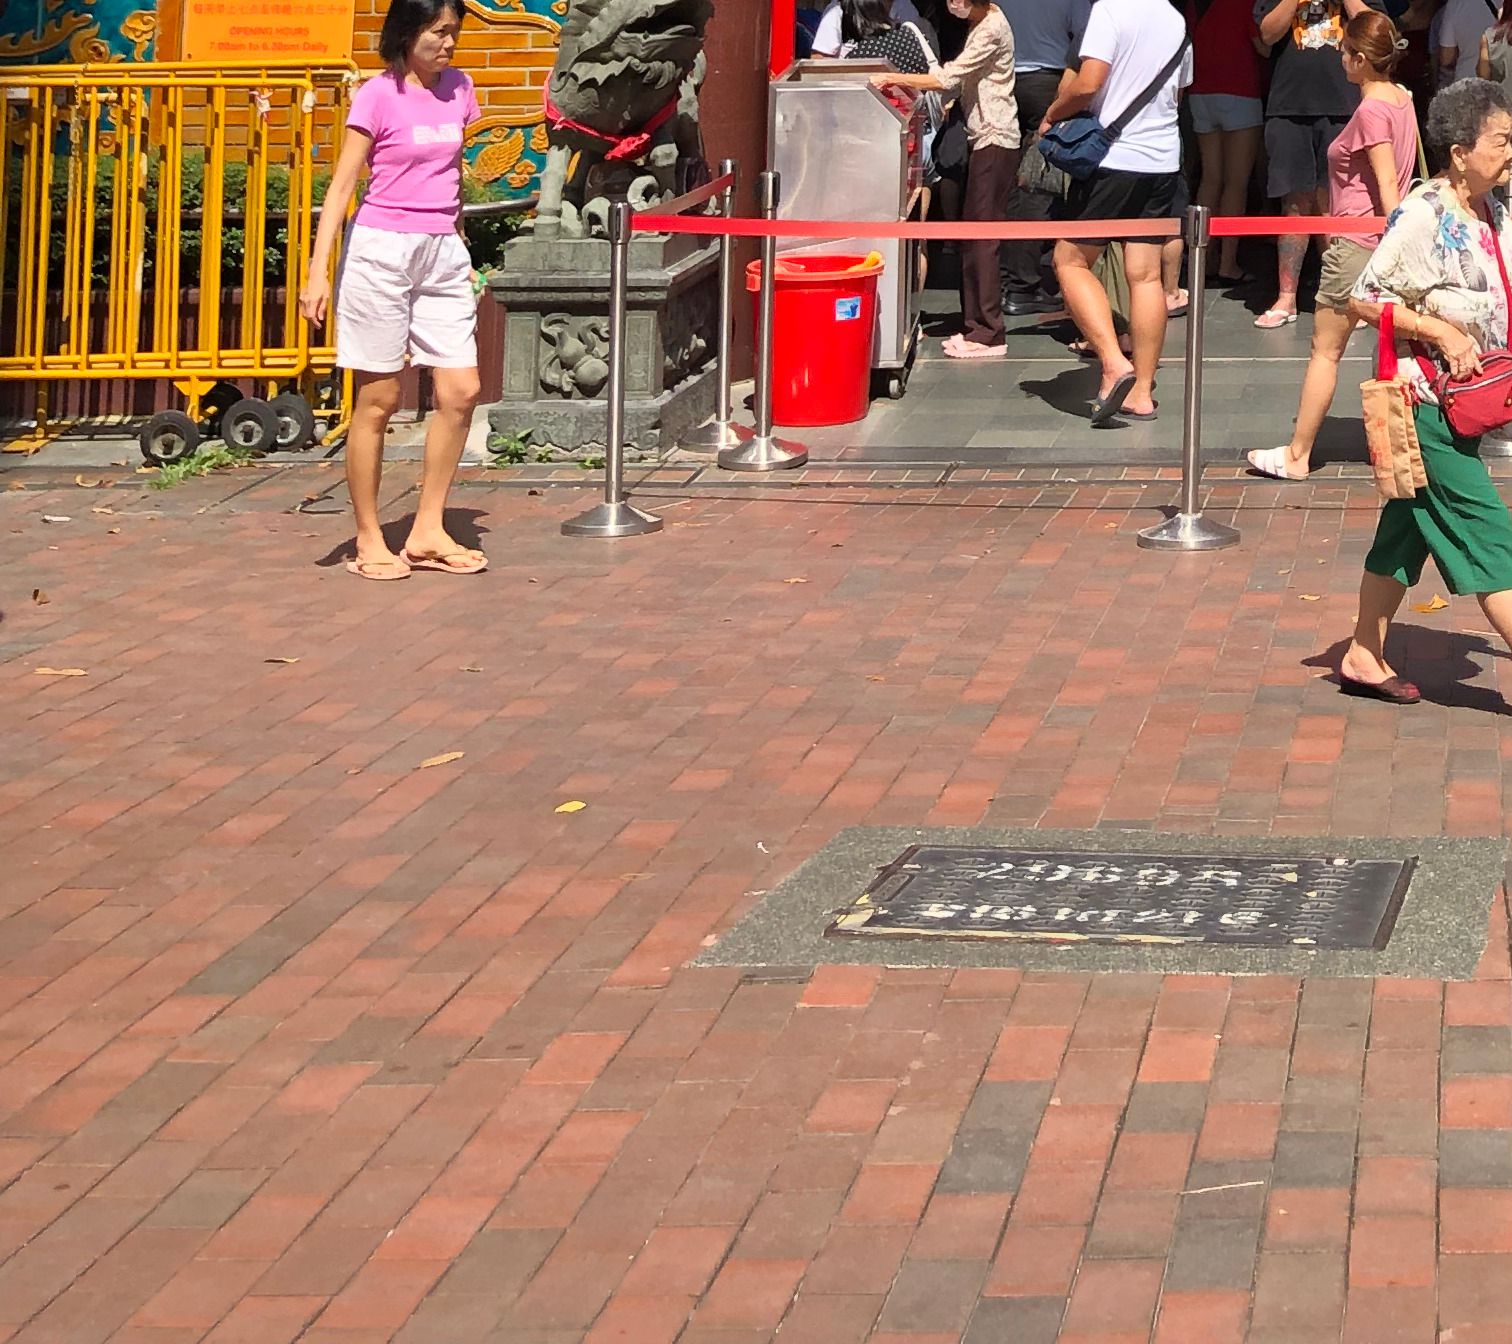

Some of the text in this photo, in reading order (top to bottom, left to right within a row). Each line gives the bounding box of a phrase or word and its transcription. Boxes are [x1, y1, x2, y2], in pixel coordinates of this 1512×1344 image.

[229, 26, 309, 36] OPENING HOURS
[301, 41, 329, 54] Daily
